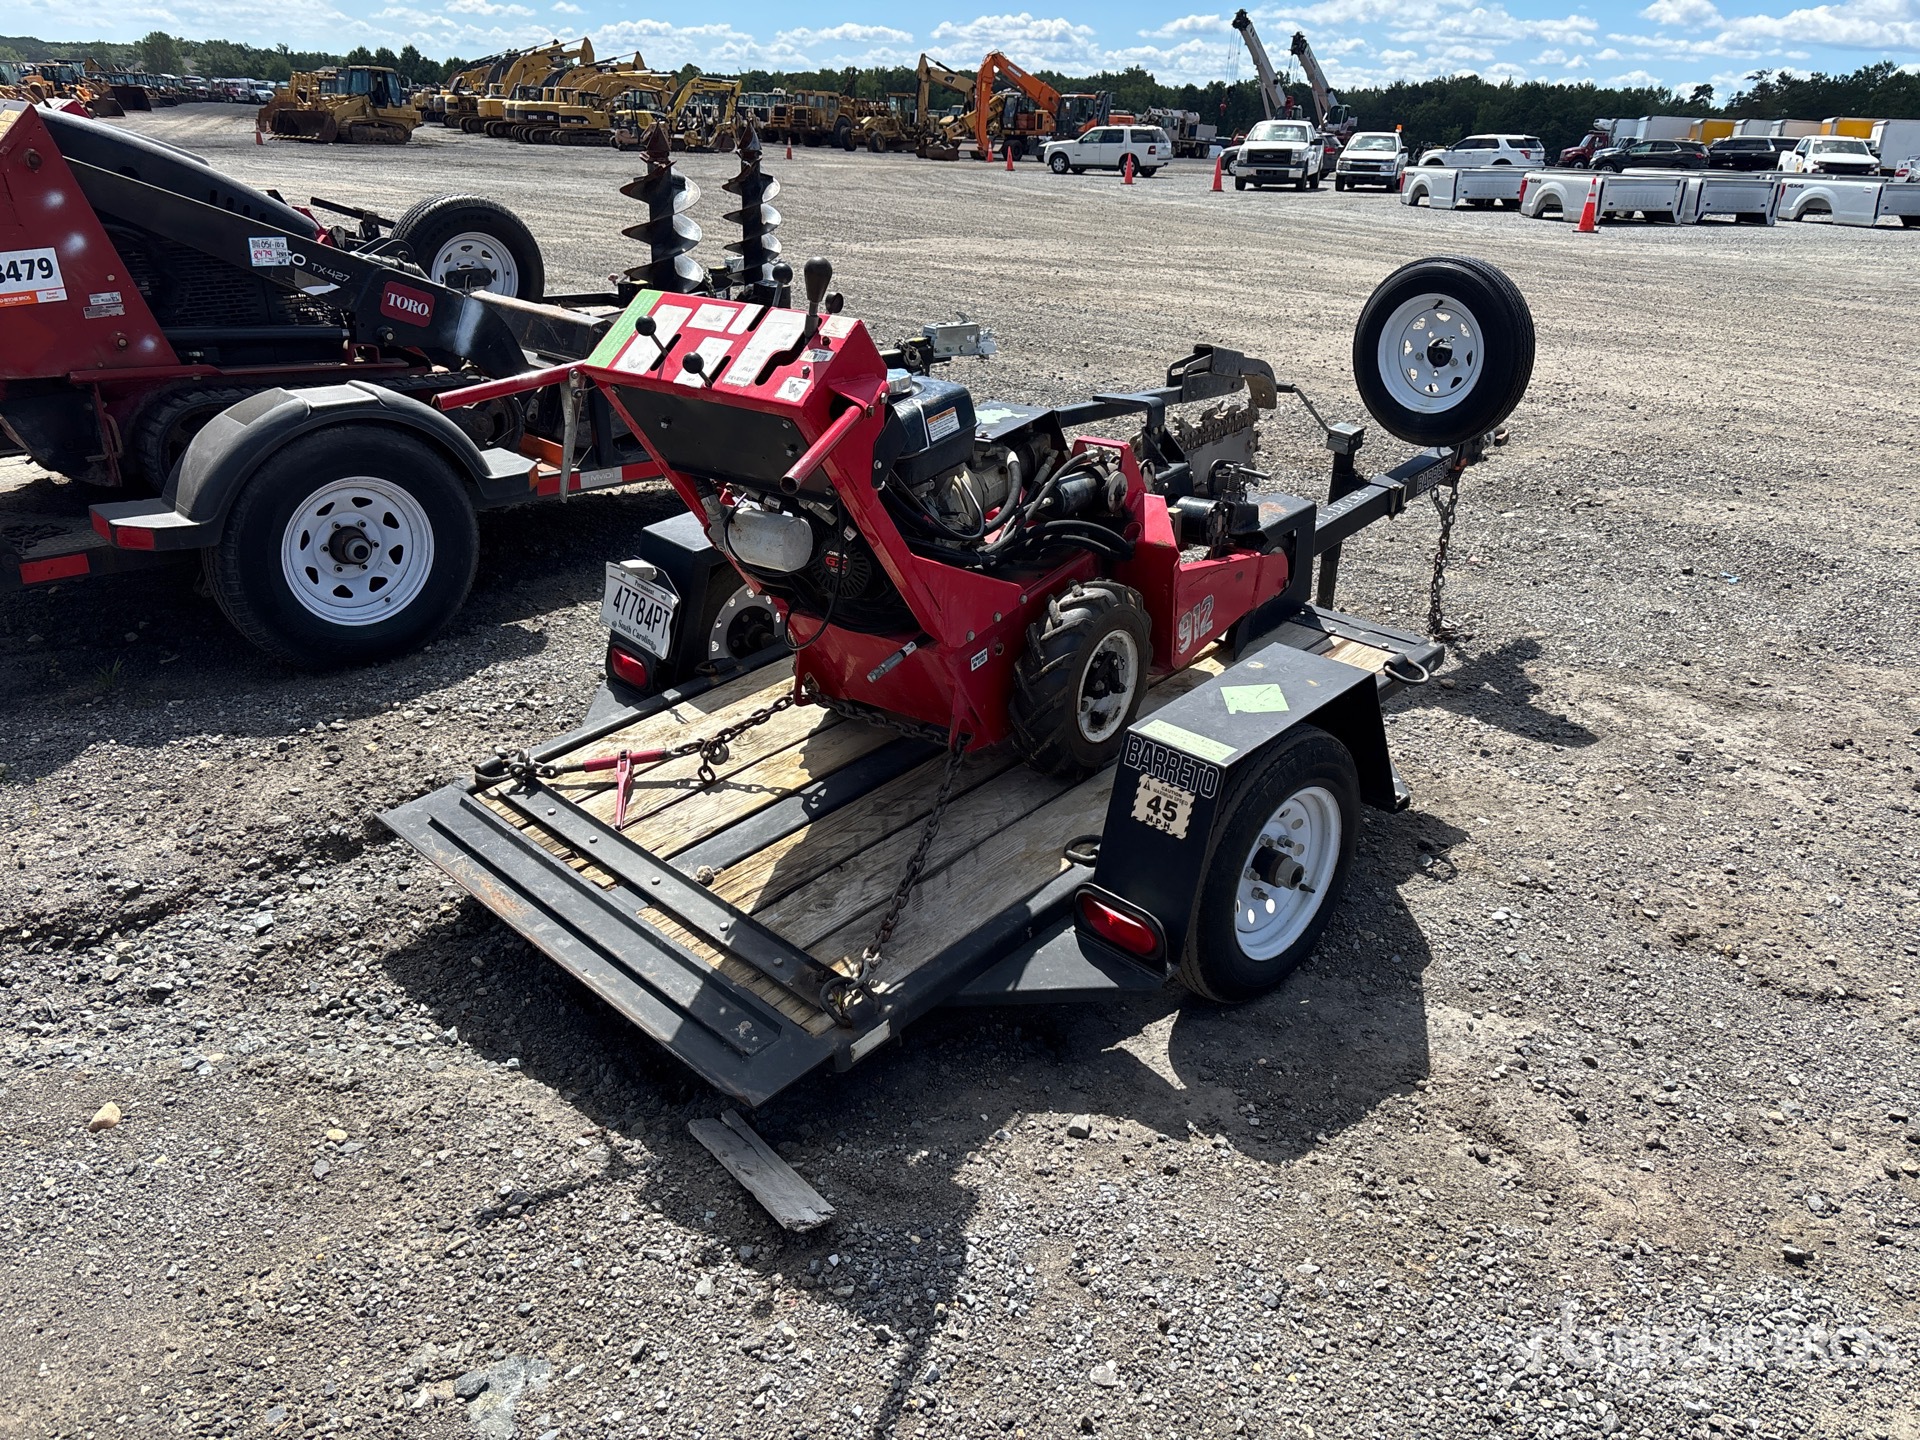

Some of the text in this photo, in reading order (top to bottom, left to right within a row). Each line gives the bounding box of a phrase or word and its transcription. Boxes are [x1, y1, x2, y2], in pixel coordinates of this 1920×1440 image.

[386, 292, 429, 316] TORO
[613, 585, 670, 639] 47784PT
[1178, 594, 1214, 654] 912
[618, 620, 632, 634] South
[1124, 734, 1220, 799] BARRETO
[1152, 788, 1188, 807] MAXIMUM SPEED
[1161, 786, 1182, 798] CAUTION
[1146, 795, 1178, 822] 45
[1146, 814, 1172, 832] M.P.H.
